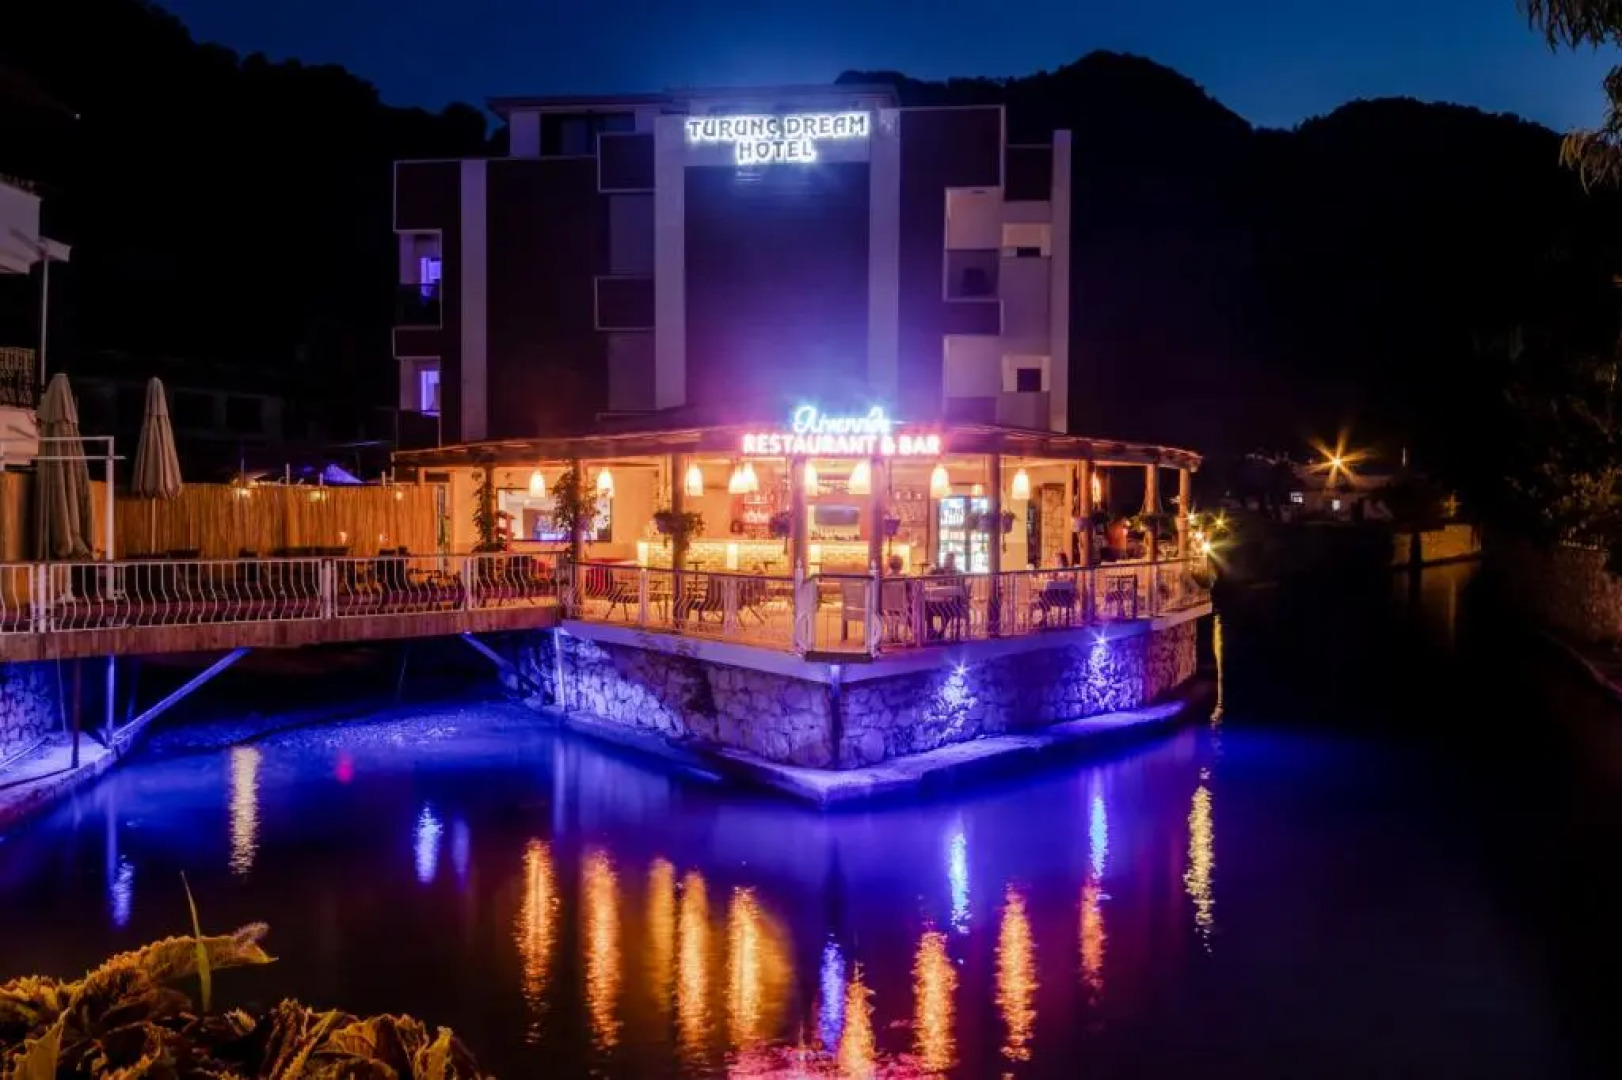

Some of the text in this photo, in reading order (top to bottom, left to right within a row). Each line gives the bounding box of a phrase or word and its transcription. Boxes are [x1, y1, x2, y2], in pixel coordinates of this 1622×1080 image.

[786, 114, 866, 136] DREAM
[738, 140, 812, 160] HOTEL
[743, 433, 877, 454] RESTAURANT
[899, 434, 940, 455] BAR
